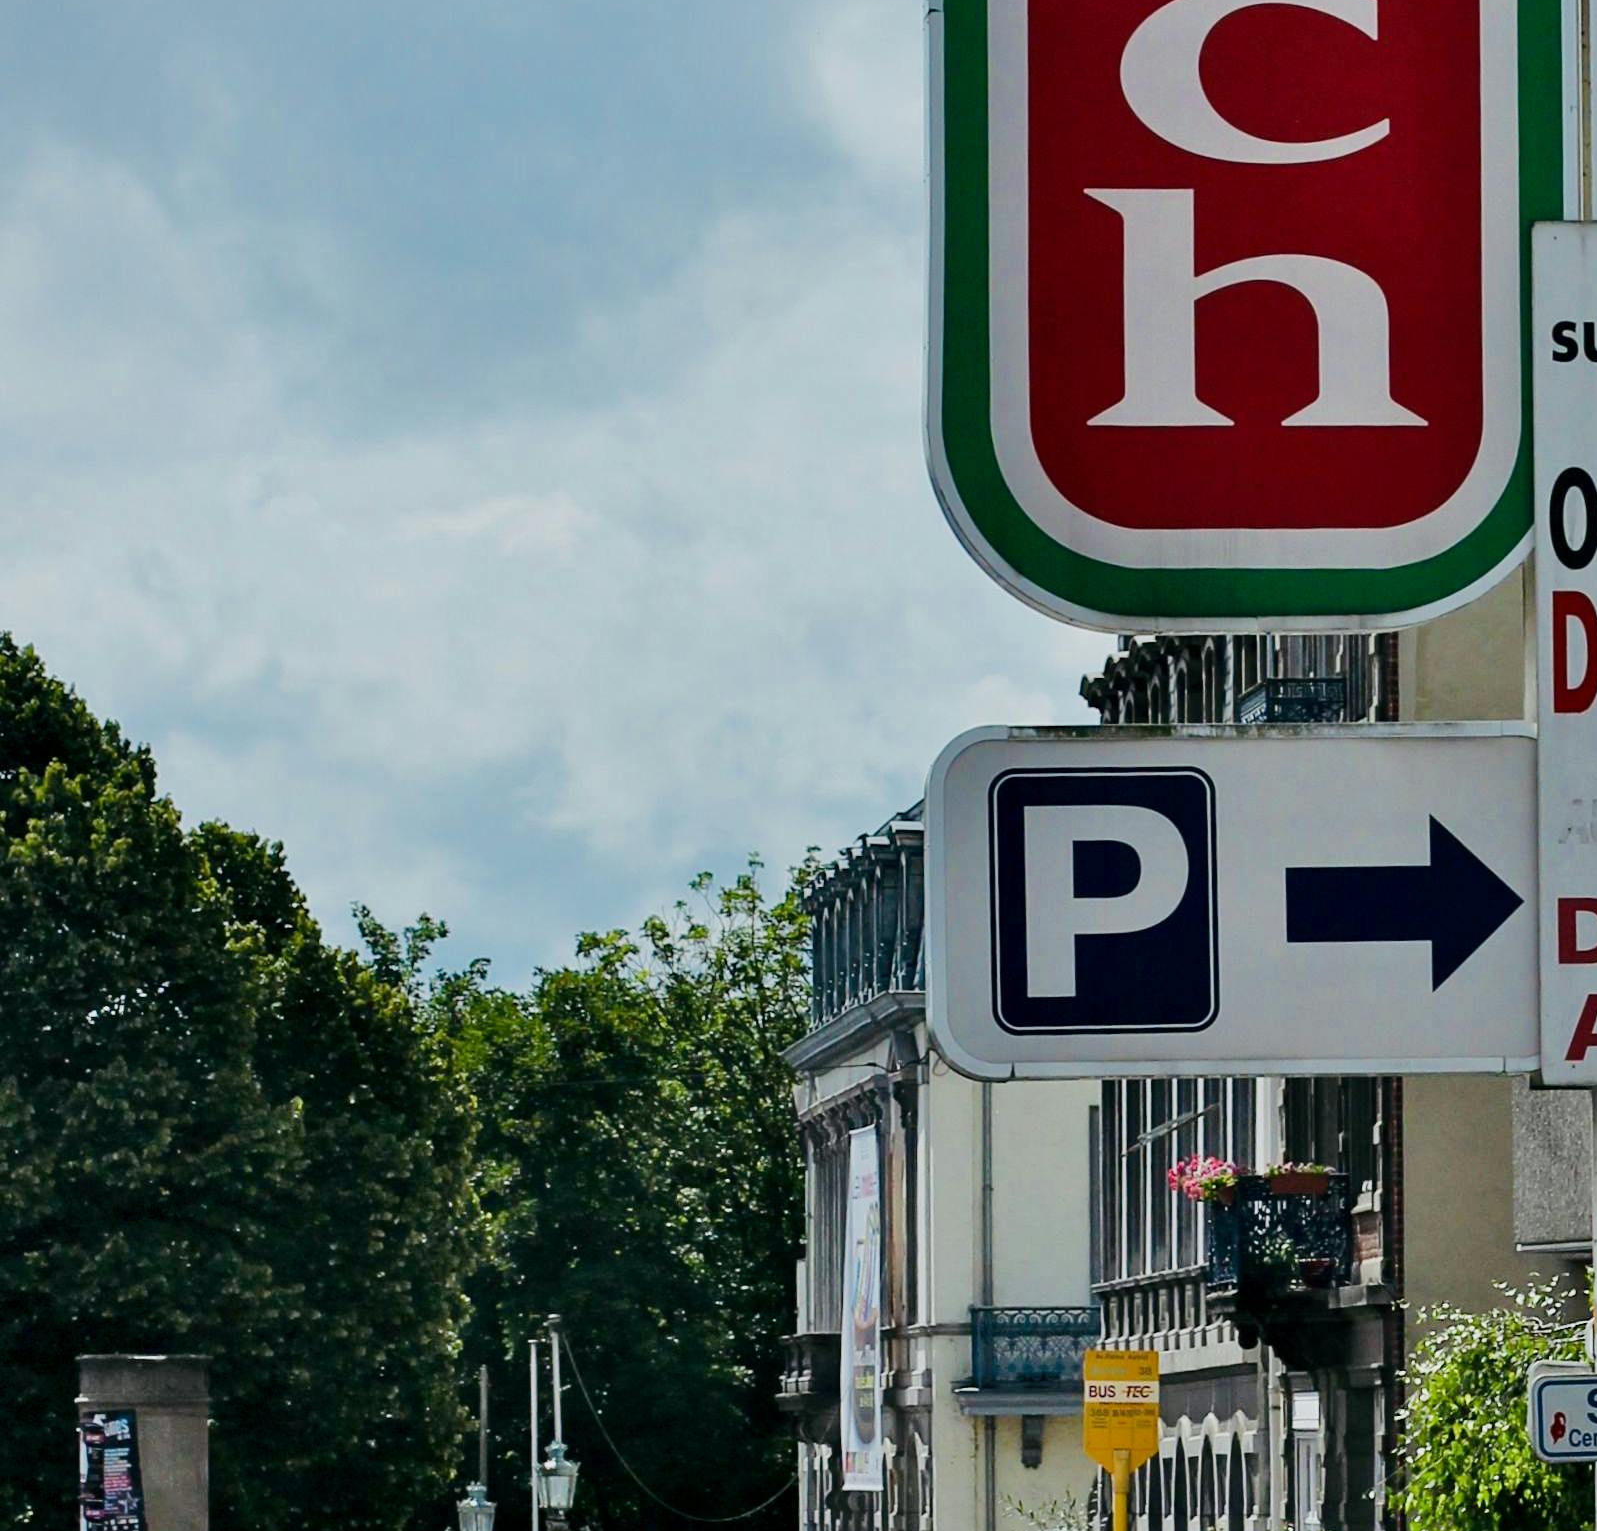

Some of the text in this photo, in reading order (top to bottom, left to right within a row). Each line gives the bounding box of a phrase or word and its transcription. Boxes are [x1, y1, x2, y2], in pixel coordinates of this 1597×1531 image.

[1023, 803, 1190, 999] P
[1088, 1384, 1153, 1399] BUS TEC
